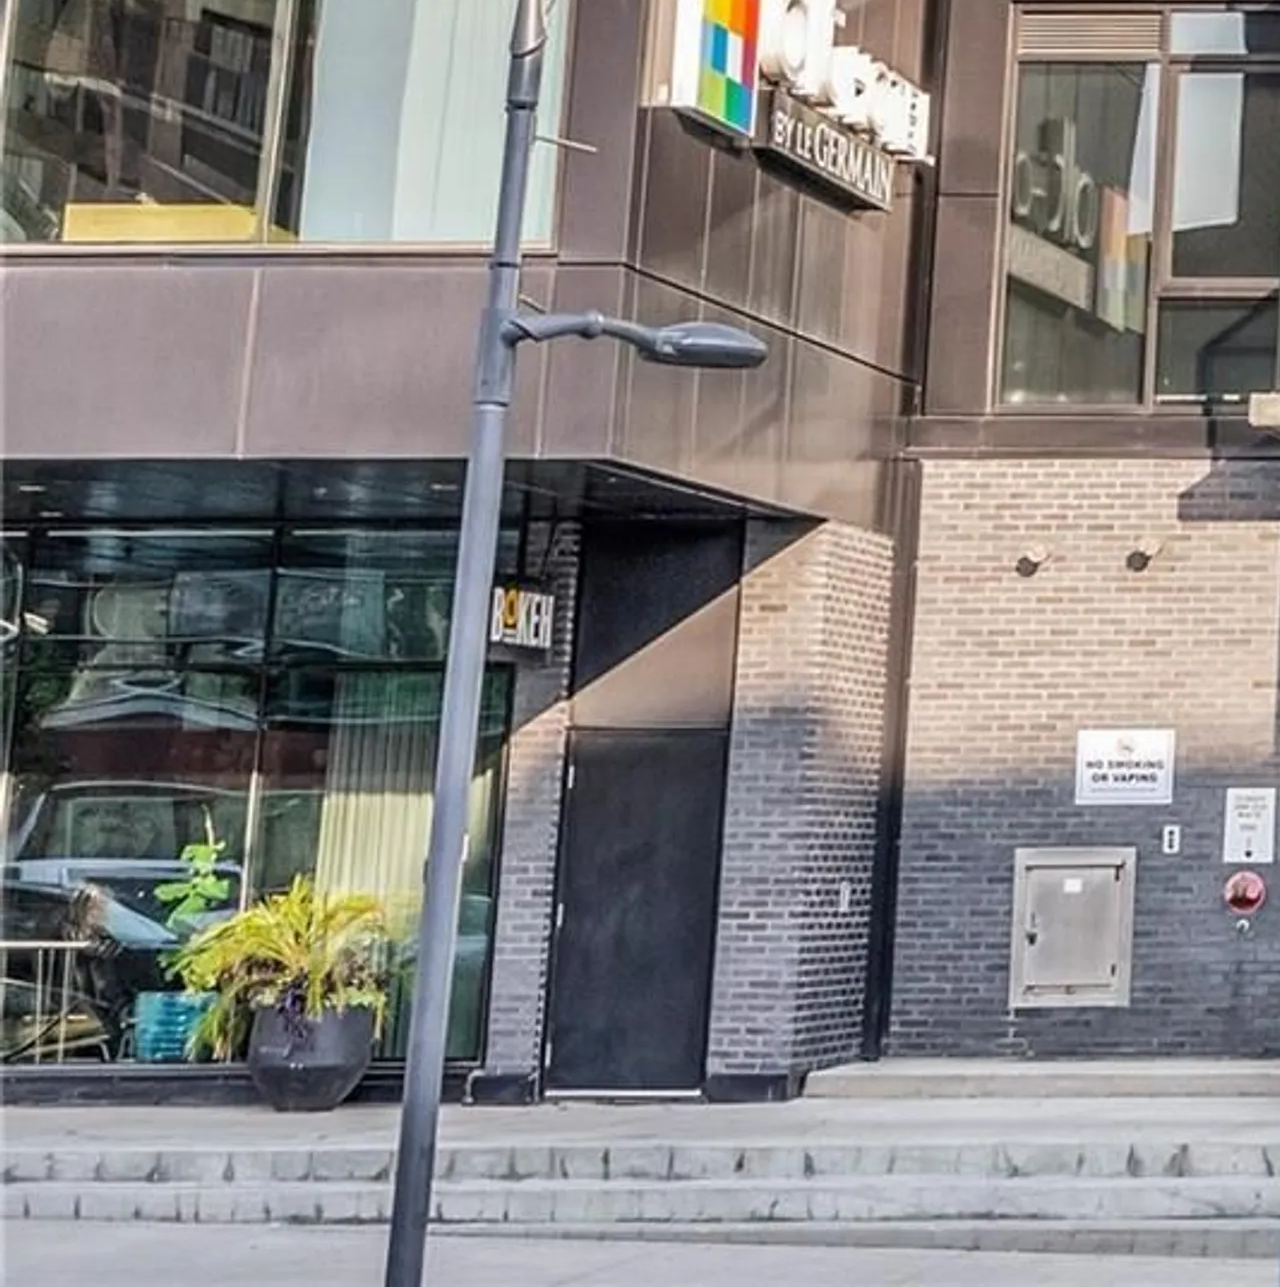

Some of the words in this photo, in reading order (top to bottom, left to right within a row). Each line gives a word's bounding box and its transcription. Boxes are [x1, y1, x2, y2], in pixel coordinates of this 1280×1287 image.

[775, 110, 796, 149] BY
[796, 121, 813, 160] LE
[814, 121, 894, 206] GERMAIN
[490, 586, 555, 648] BOKEH
[1085, 759, 1104, 770] NO
[1107, 759, 1164, 770] SMOKING
[1091, 772, 1108, 784] OR
[1111, 772, 1158, 783] VAPING
